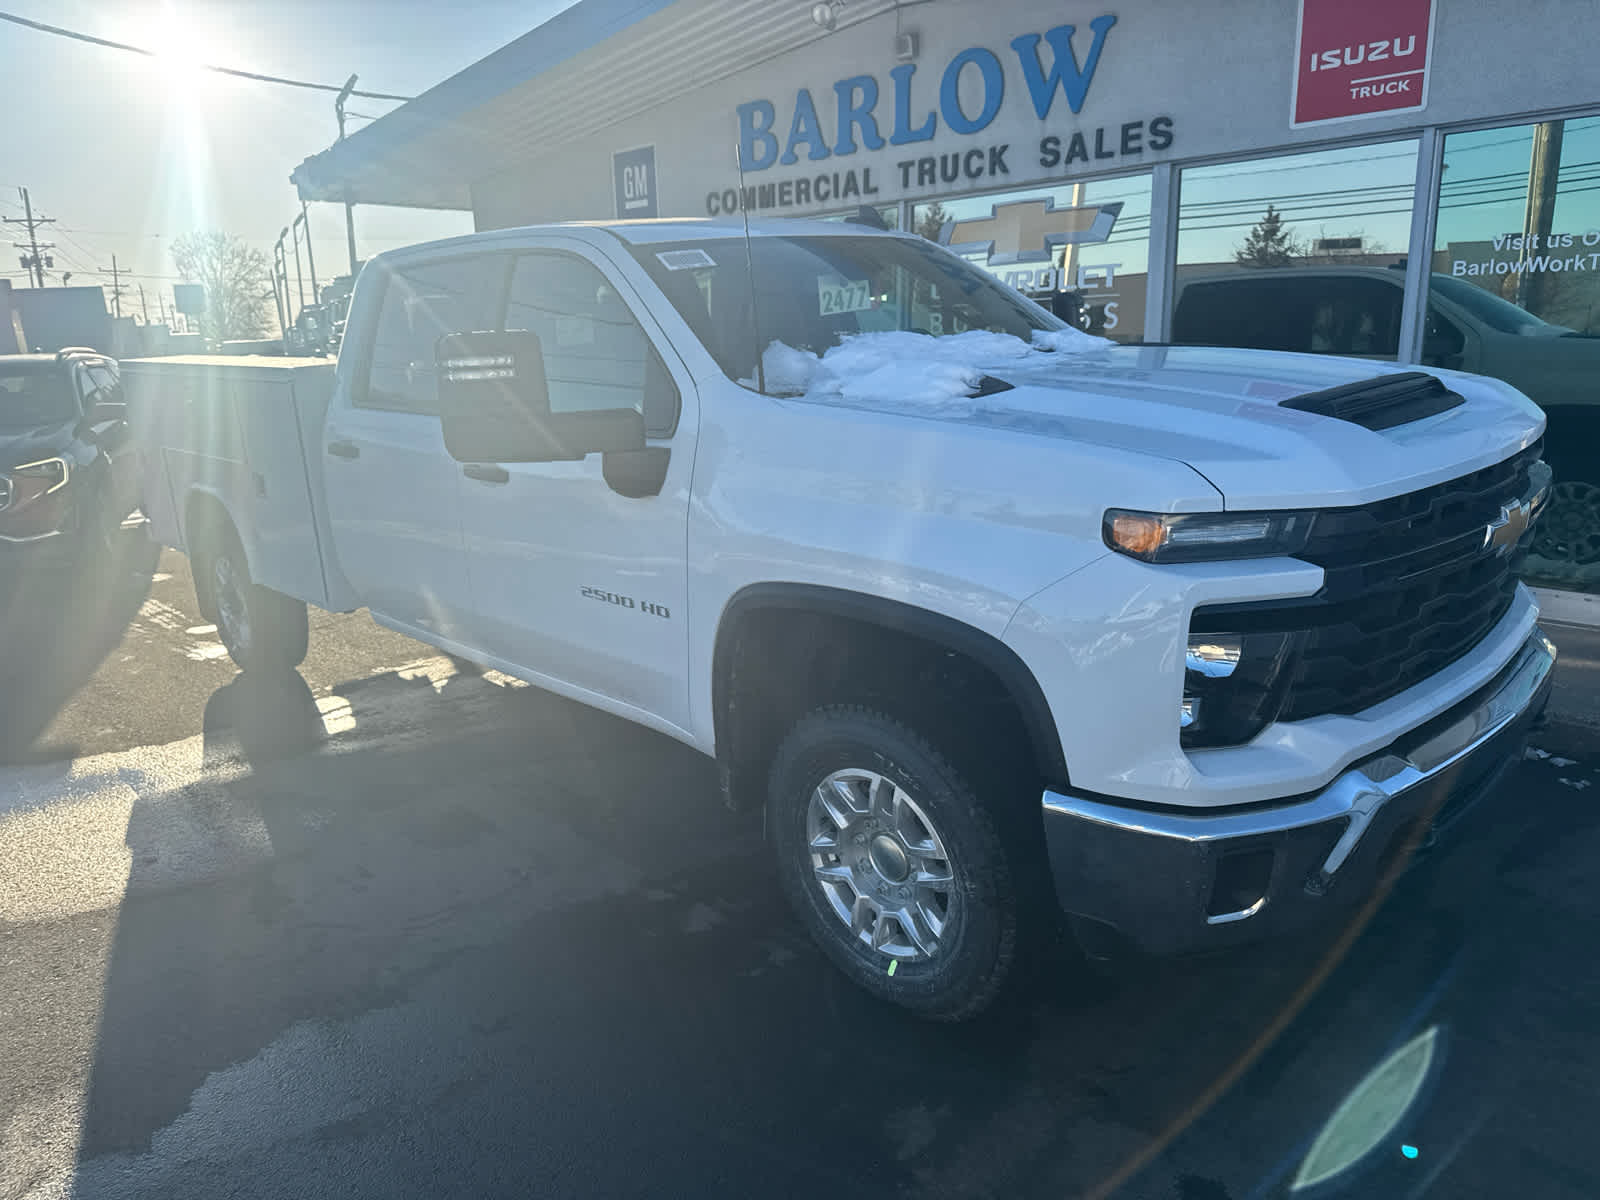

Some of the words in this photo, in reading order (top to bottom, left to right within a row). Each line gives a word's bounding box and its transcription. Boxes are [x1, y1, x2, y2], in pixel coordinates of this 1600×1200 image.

[1310, 35, 1416, 72] ISUZU
[735, 14, 1118, 172] BARLOW
[1350, 79, 1410, 100] TRUCK
[623, 164, 648, 199] GM
[705, 167, 879, 217] COMMERCIAL
[897, 144, 1010, 188] TRUCK
[1039, 116, 1175, 168] SALES
[1492, 231, 1540, 252] Visit
[1546, 234, 1574, 249] us
[1451, 252, 1600, 277] BarlowWorkT
[822, 285, 867, 313] 2477
[580, 585, 635, 609] 2500
[640, 600, 671, 619] HD
